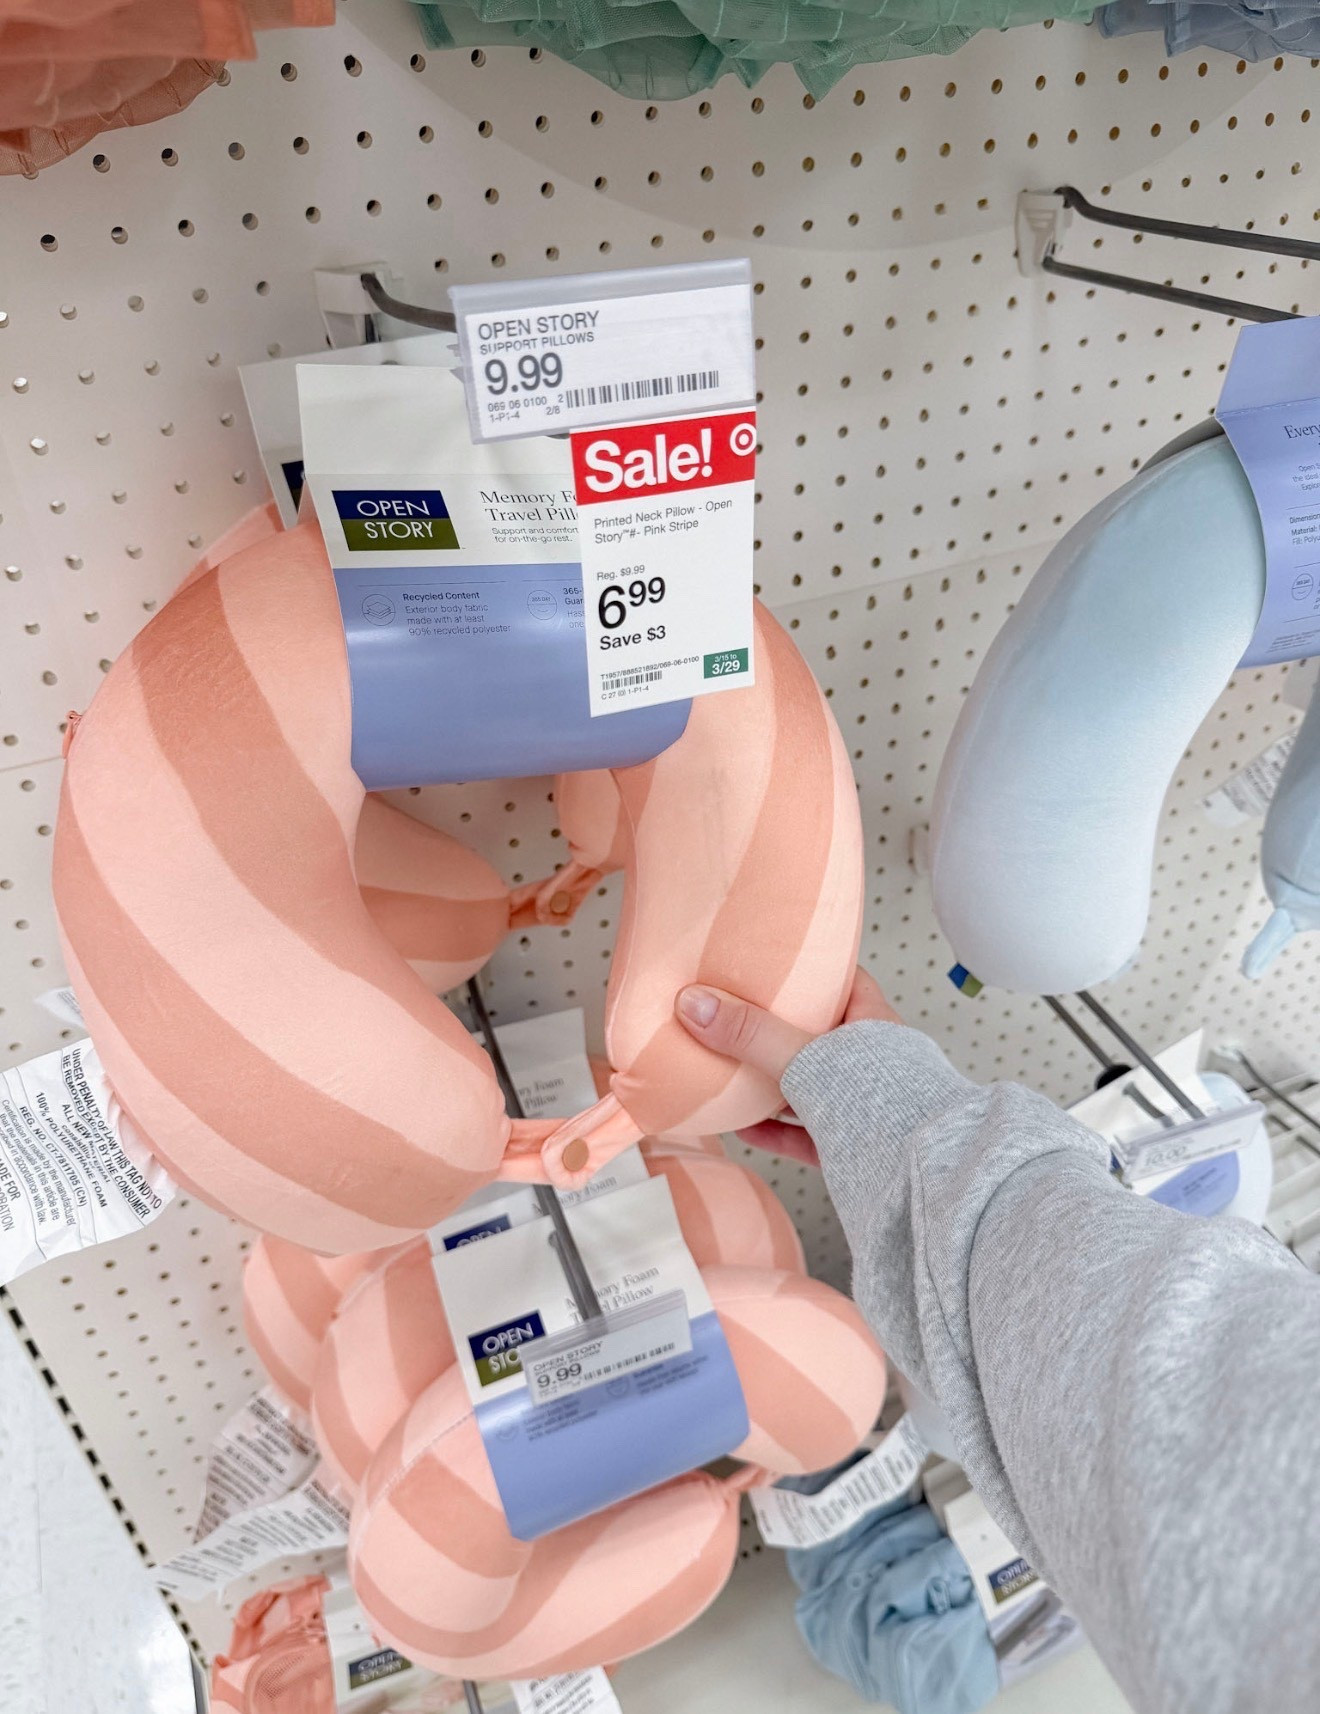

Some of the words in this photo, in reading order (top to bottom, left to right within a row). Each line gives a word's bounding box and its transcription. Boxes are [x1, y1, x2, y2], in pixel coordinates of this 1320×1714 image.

[478, 317, 531, 340] OPEN
[537, 310, 599, 333] STORY
[480, 339, 538, 355] SUPPORT
[541, 331, 595, 348] PILLOWS
[485, 352, 563, 396] 9.99
[509, 399, 521, 410] 06
[523, 396, 548, 408] 0100
[546, 405, 561, 416] 2/8
[584, 428, 712, 493] Sale!
[479, 490, 555, 507] Memory
[356, 499, 431, 517] OPEN
[484, 508, 542, 521] Travel
[545, 507, 578, 521] Pill
[594, 515, 633, 529] Printed
[635, 510, 662, 523] Neck
[665, 505, 696, 519] Pillow
[705, 499, 733, 512] Open
[363, 521, 436, 540] STORY
[492, 527, 527, 536] Support
[644, 523, 666, 536] Pink
[669, 519, 699, 532] Stripe
[1291, 525, 1317, 536] Material:
[509, 535, 552, 544] on-the-go
[553, 534, 573, 542] rest.
[597, 570, 618, 581] Reg.
[620, 564, 645, 577] $9.99
[402, 592, 444, 602] Recycled
[445, 591, 480, 600] Content
[405, 605, 438, 614] Exterior
[441, 604, 462, 614] body
[465, 603, 489, 612] fabric
[407, 616, 432, 625] made
[434, 615, 452, 623] with
[454, 615, 463, 623] at
[465, 614, 484, 623] least
[409, 627, 432, 636] 90%
[433, 626, 470, 635] recycled
[472, 624, 511, 634] polyester
[598, 630, 641, 650] Save
[646, 624, 666, 641] $3
[714, 654, 729, 662] 3/15
[711, 660, 740, 675] 3/29
[608, 691, 616, 699] 27
[62, 1054, 71, 1069] BE
[72, 1048, 84, 1081] UNDER
[64, 1069, 85, 1113] REMOVED
[77, 1081, 102, 1118] PENALTY
[62, 1104, 75, 1122] ALL
[72, 1121, 92, 1139] NEW
[98, 1120, 109, 1132] OF
[6, 1127, 16, 1138] the
[104, 1130, 119, 1151] LAW
[10, 1148, 18, 1157] in
[14, 1138, 38, 1165] materials
[19, 1106, 35, 1127] REG.
[33, 1128, 46, 1143] NO.
[45, 1143, 81, 1186] CT-7811705
[73, 1186, 88, 1207] (CN)
[36, 1092, 50, 1117] 100%
[45, 1117, 95, 1179] POLYURETHANE
[92, 1180, 108, 1208] FOAM
[98, 1143, 110, 1156] BY
[111, 1148, 131, 1169] THIS
[1, 1099, 27, 1138] Certification
[23, 1137, 33, 1145] is
[29, 1143, 46, 1160] made
[42, 1160, 51, 1169] by
[49, 1169, 58, 1181] the
[54, 1180, 77, 1226] manufacturer
[34, 1165, 42, 1173] in
[104, 1156, 119, 1175] THE
[14, 1156, 38, 1194] accordance
[38, 1172, 49, 1186] this
[125, 1166, 143, 1184] TAG
[5, 1180, 21, 1201] FOR
[44, 1185, 57, 1208] article
[114, 1175, 151, 1219] CONSUMER
[33, 1194, 45, 1210] with
[150, 1196, 162, 1210] TO
[36, 1209, 47, 1225] law.
[50, 1206, 61, 1221] are
[622, 1267, 659, 1287] Foam
[612, 1284, 653, 1307] Pillow
[483, 1322, 534, 1356] OPEN
[537, 1362, 582, 1389] 9.99
